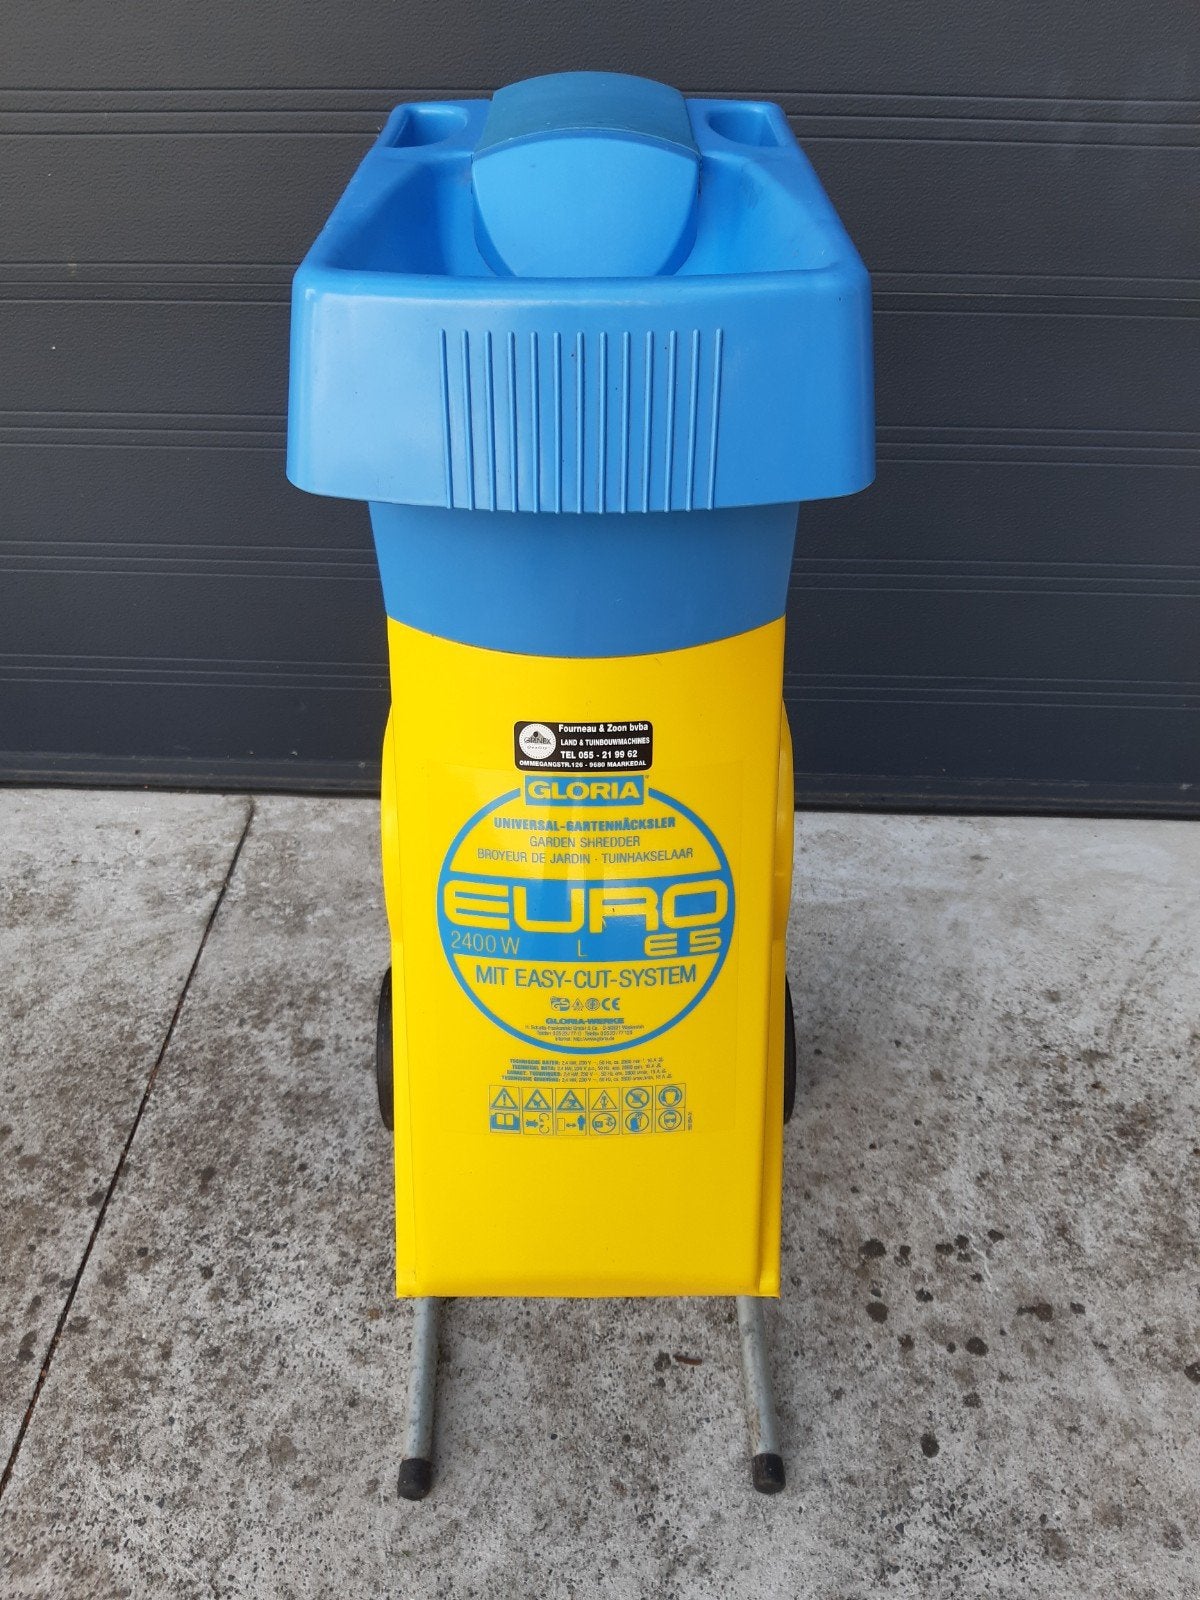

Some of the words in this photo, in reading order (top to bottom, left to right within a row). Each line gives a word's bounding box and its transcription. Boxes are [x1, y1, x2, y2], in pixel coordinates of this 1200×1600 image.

[559, 724, 597, 732] Fourneau
[599, 724, 605, 732] &
[607, 724, 627, 732] Zoon
[630, 723, 649, 731] bvba
[586, 737, 650, 746] TUINBOUWMACHINES
[561, 751, 576, 759] TEL
[579, 751, 594, 759] 055
[615, 750, 625, 758] 99
[627, 750, 638, 758] 62
[528, 780, 641, 800] GLORIA
[530, 836, 576, 847] GARDEN
[580, 835, 640, 847] SHREDDER
[477, 848, 527, 862] BROYEUR
[531, 852, 546, 863] DE
[549, 852, 591, 864] JARDIN
[602, 847, 694, 863] TUINHAKSELAAR
[443, 878, 729, 934] EURO
[450, 930, 497, 954] 2400
[500, 937, 520, 955] W
[475, 964, 509, 985] MIT
[515, 964, 697, 989] EASY-CUT-SYSTEM
